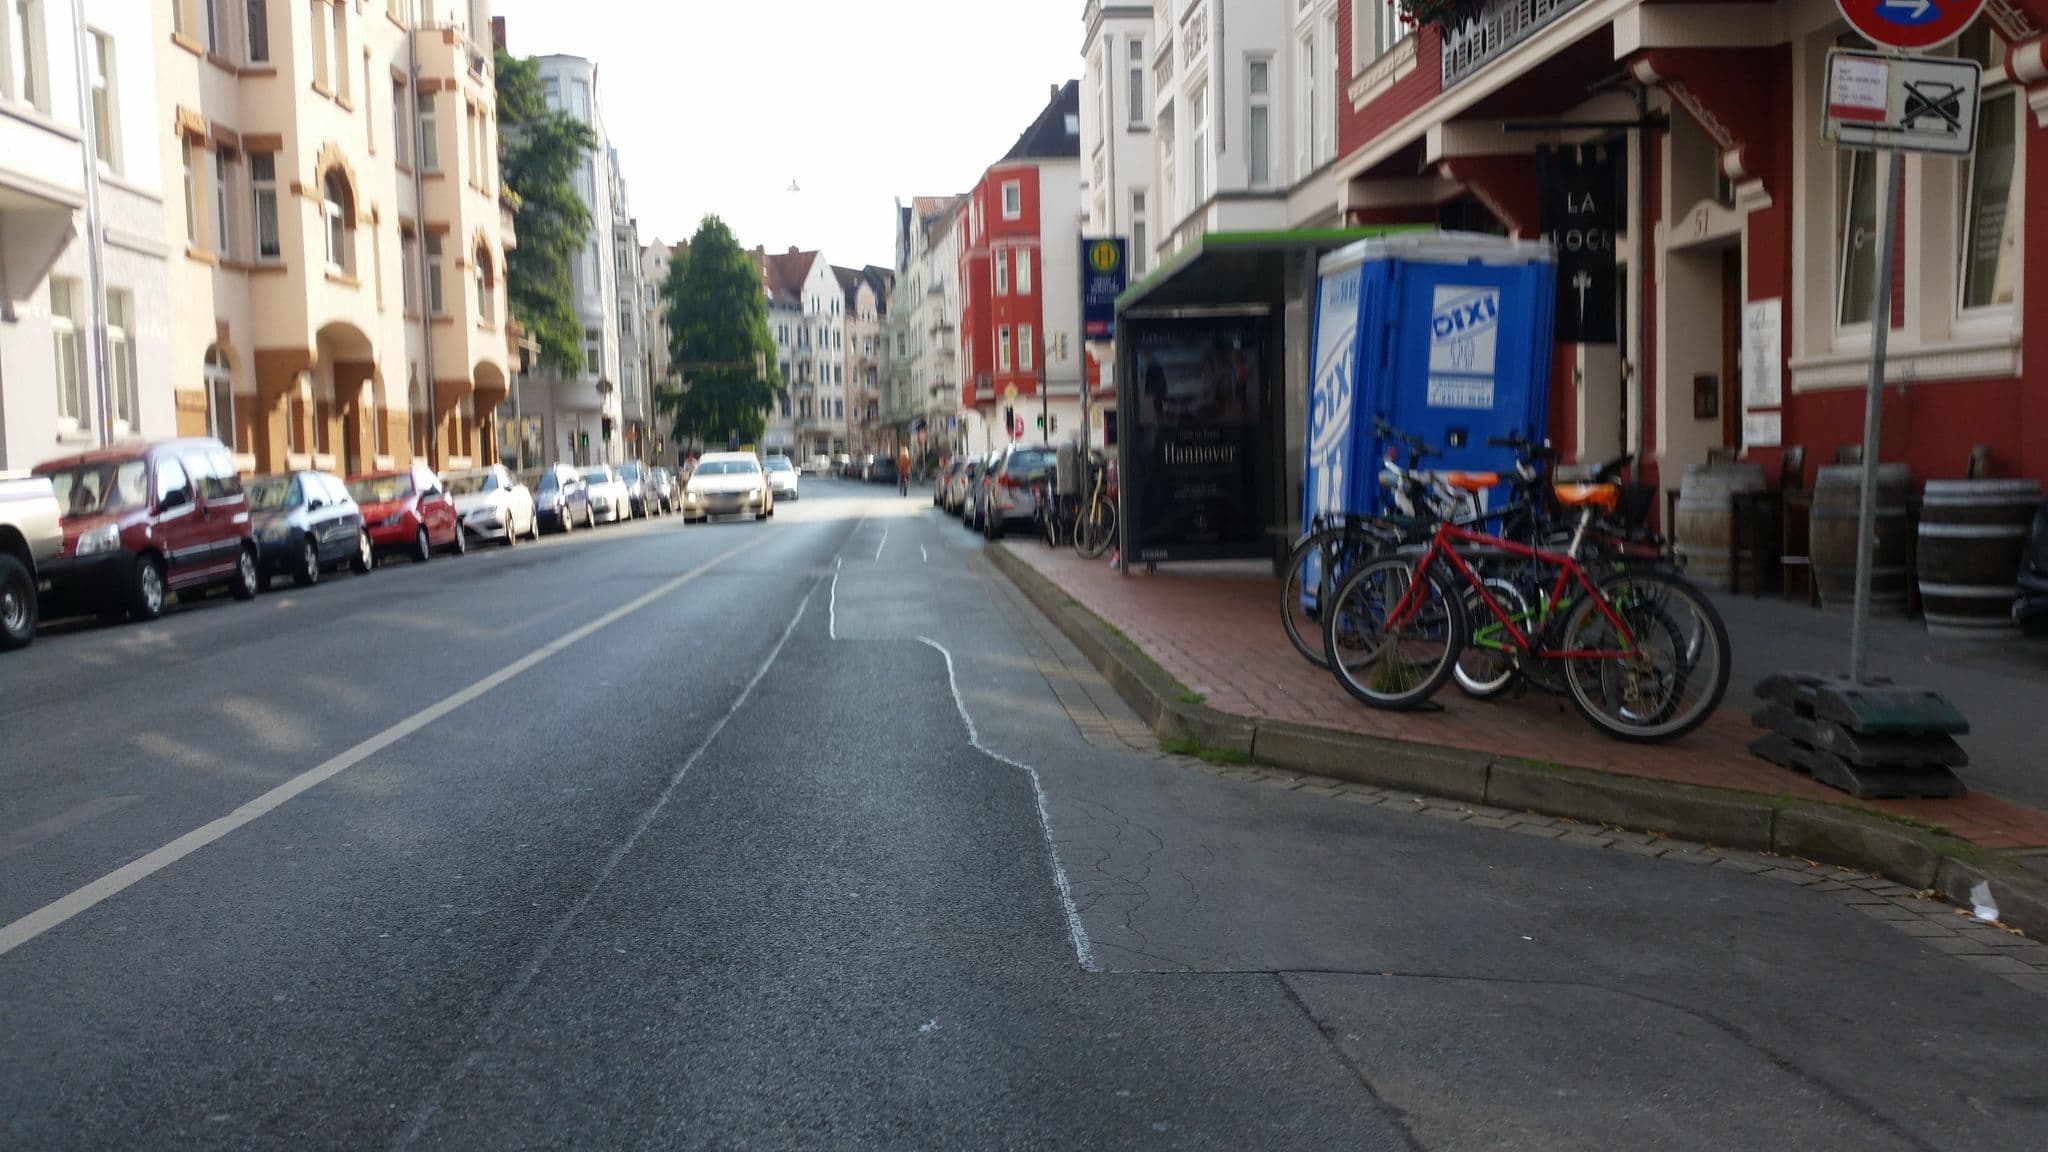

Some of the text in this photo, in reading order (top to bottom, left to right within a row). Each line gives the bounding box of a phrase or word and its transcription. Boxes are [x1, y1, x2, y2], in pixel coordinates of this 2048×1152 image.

[1567, 191, 1596, 214] LA
[1432, 295, 1496, 339] DIXI
[1164, 441, 1237, 465] Hannover
